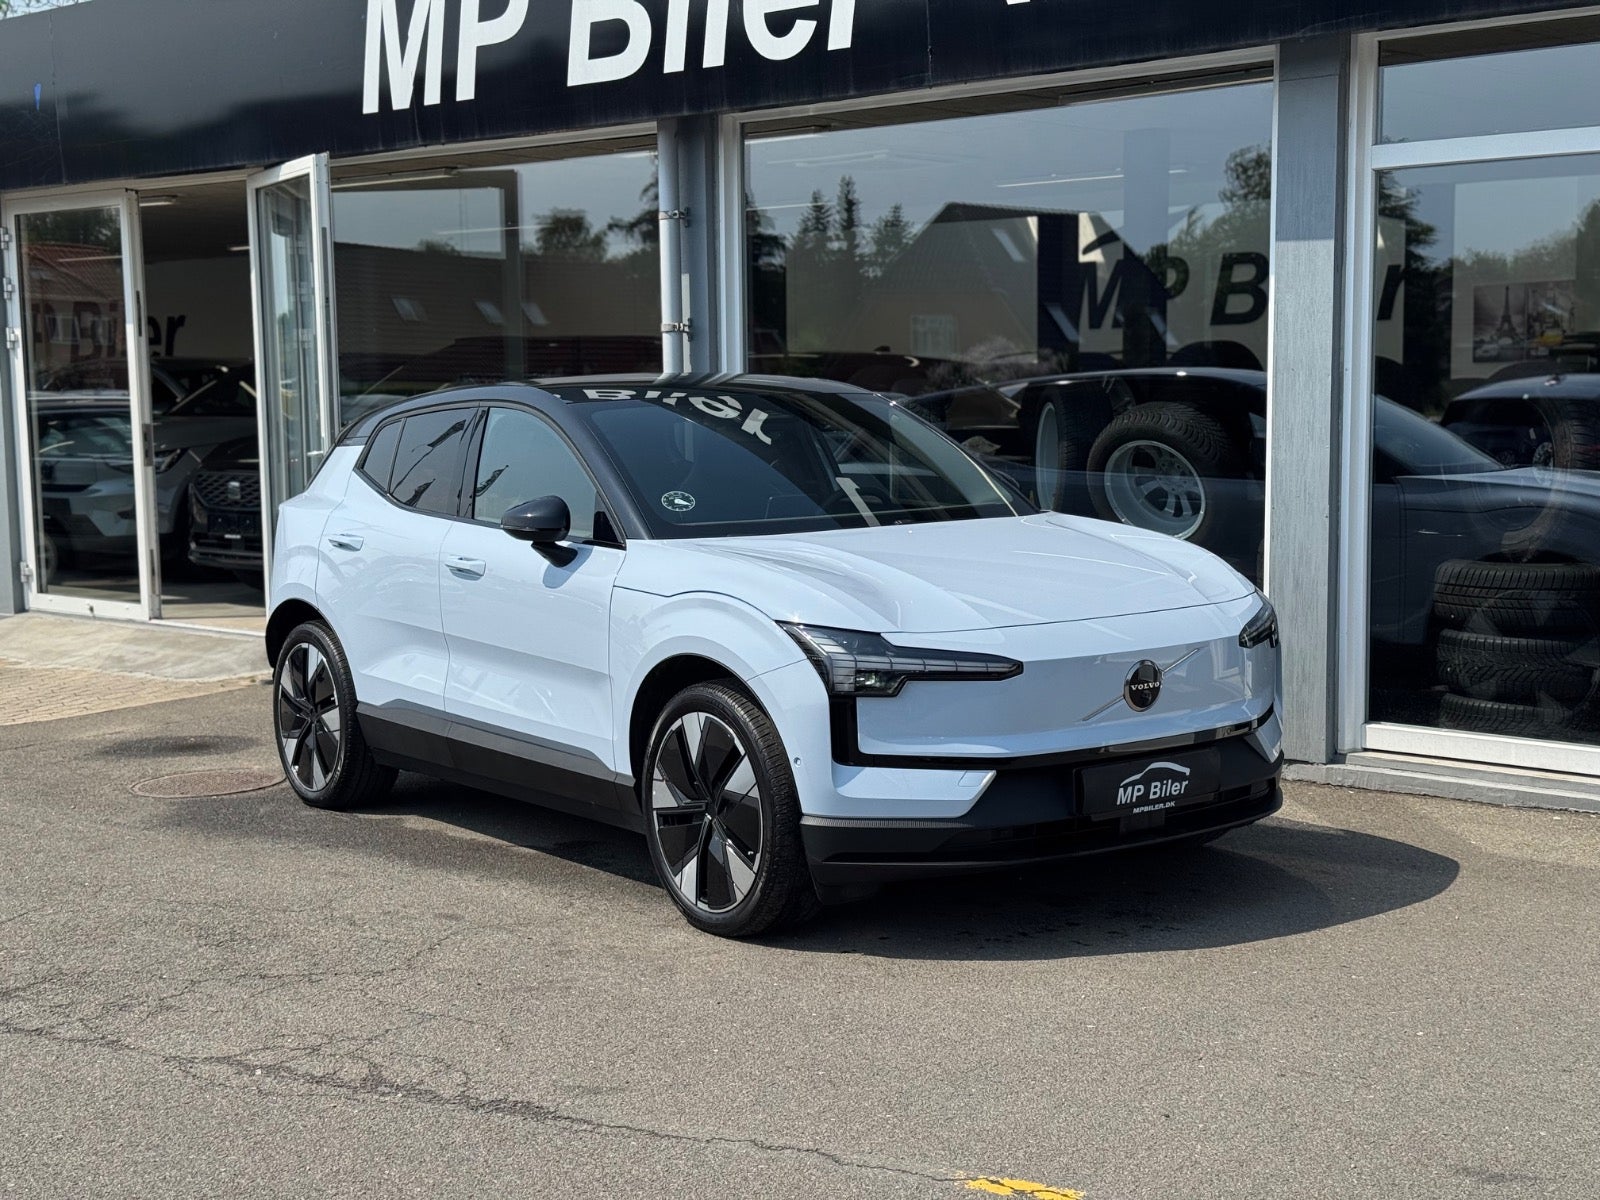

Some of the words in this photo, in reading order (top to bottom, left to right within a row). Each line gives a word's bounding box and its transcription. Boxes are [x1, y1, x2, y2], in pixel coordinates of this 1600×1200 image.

[362, 0, 529, 114] MP
[1131, 681, 1160, 691] VOLVO
[1116, 784, 1145, 806] MP
[1149, 779, 1189, 800] Biler
[1132, 801, 1176, 814] MPBILER.DK
